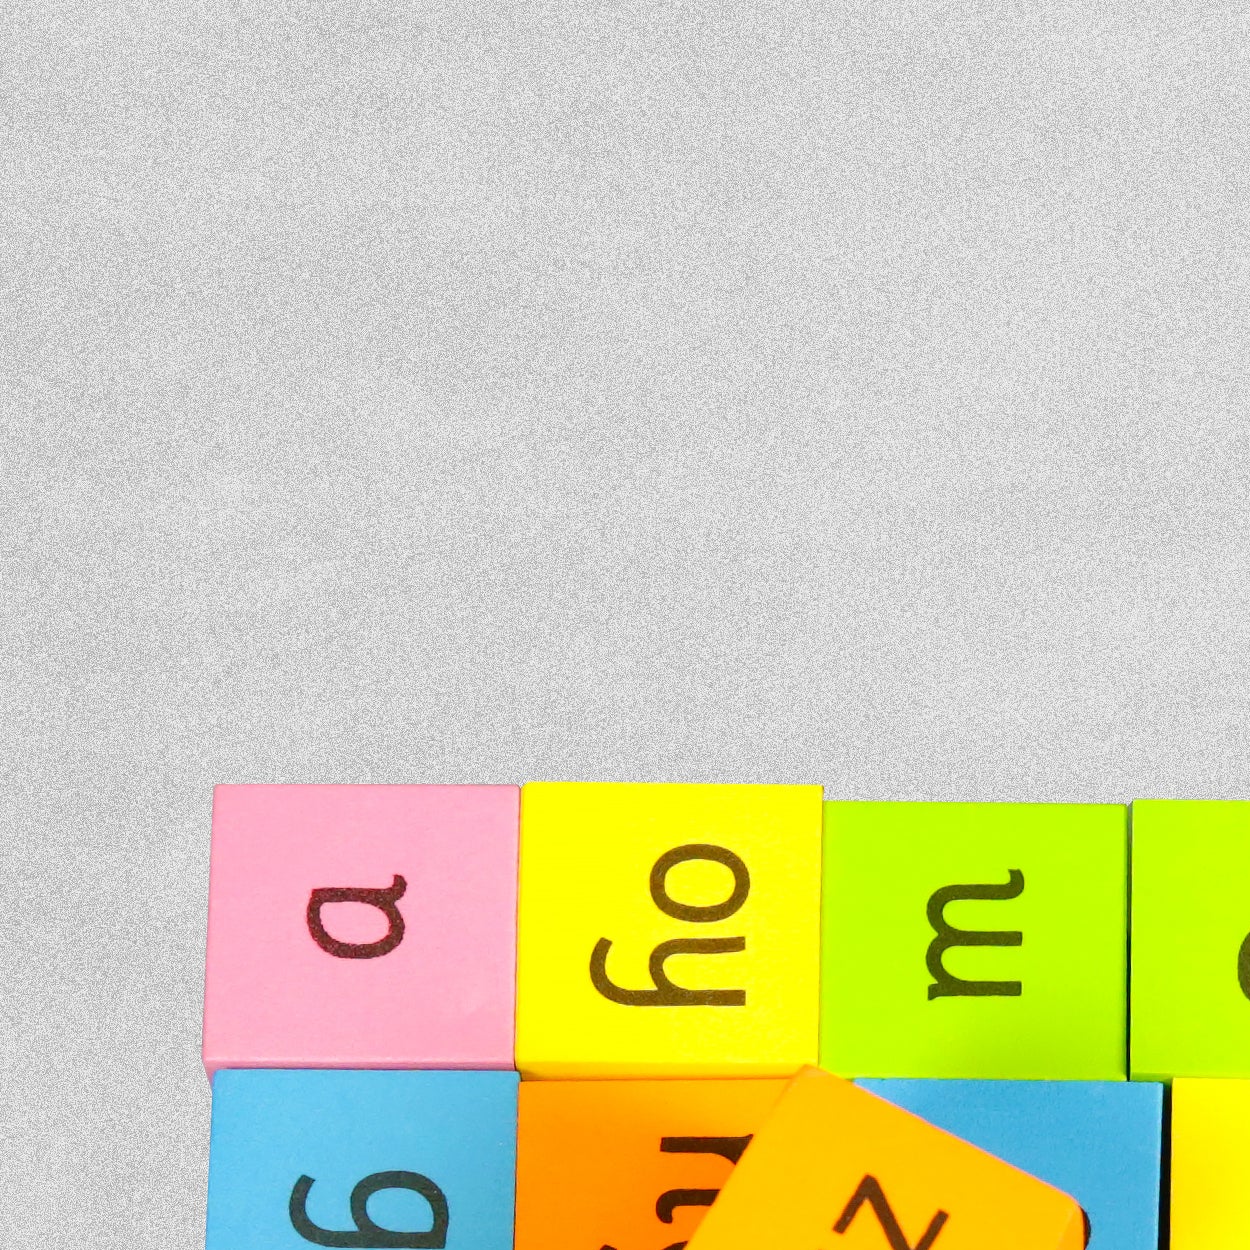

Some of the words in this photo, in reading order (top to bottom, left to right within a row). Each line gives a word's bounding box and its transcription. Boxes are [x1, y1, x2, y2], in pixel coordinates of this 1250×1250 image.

[306, 874, 407, 960] a
[590, 843, 750, 1006] oy
[925, 869, 1025, 1001] m
[288, 1170, 450, 1250] g
